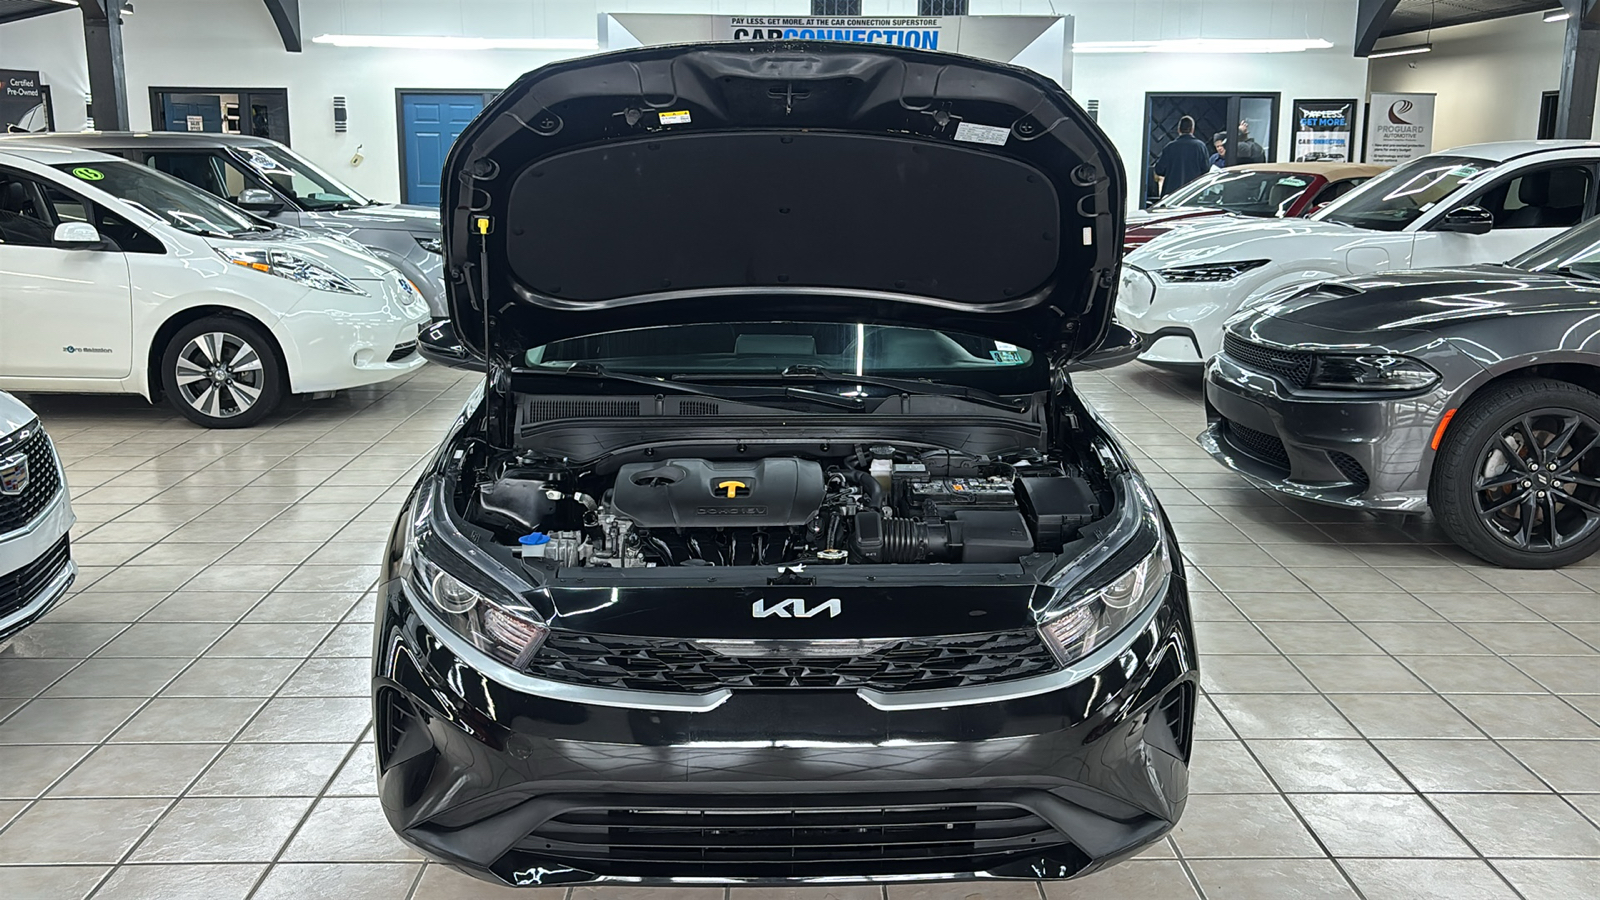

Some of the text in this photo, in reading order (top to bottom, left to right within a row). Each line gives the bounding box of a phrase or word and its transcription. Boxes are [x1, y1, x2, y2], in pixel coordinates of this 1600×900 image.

[10, 78, 34, 87] Certified
[6, 87, 39, 96] Pre-Owned
[1300, 118, 1347, 126] GET MORE.
[1377, 125, 1424, 134] PROGUARD
[752, 598, 842, 618] KIA
